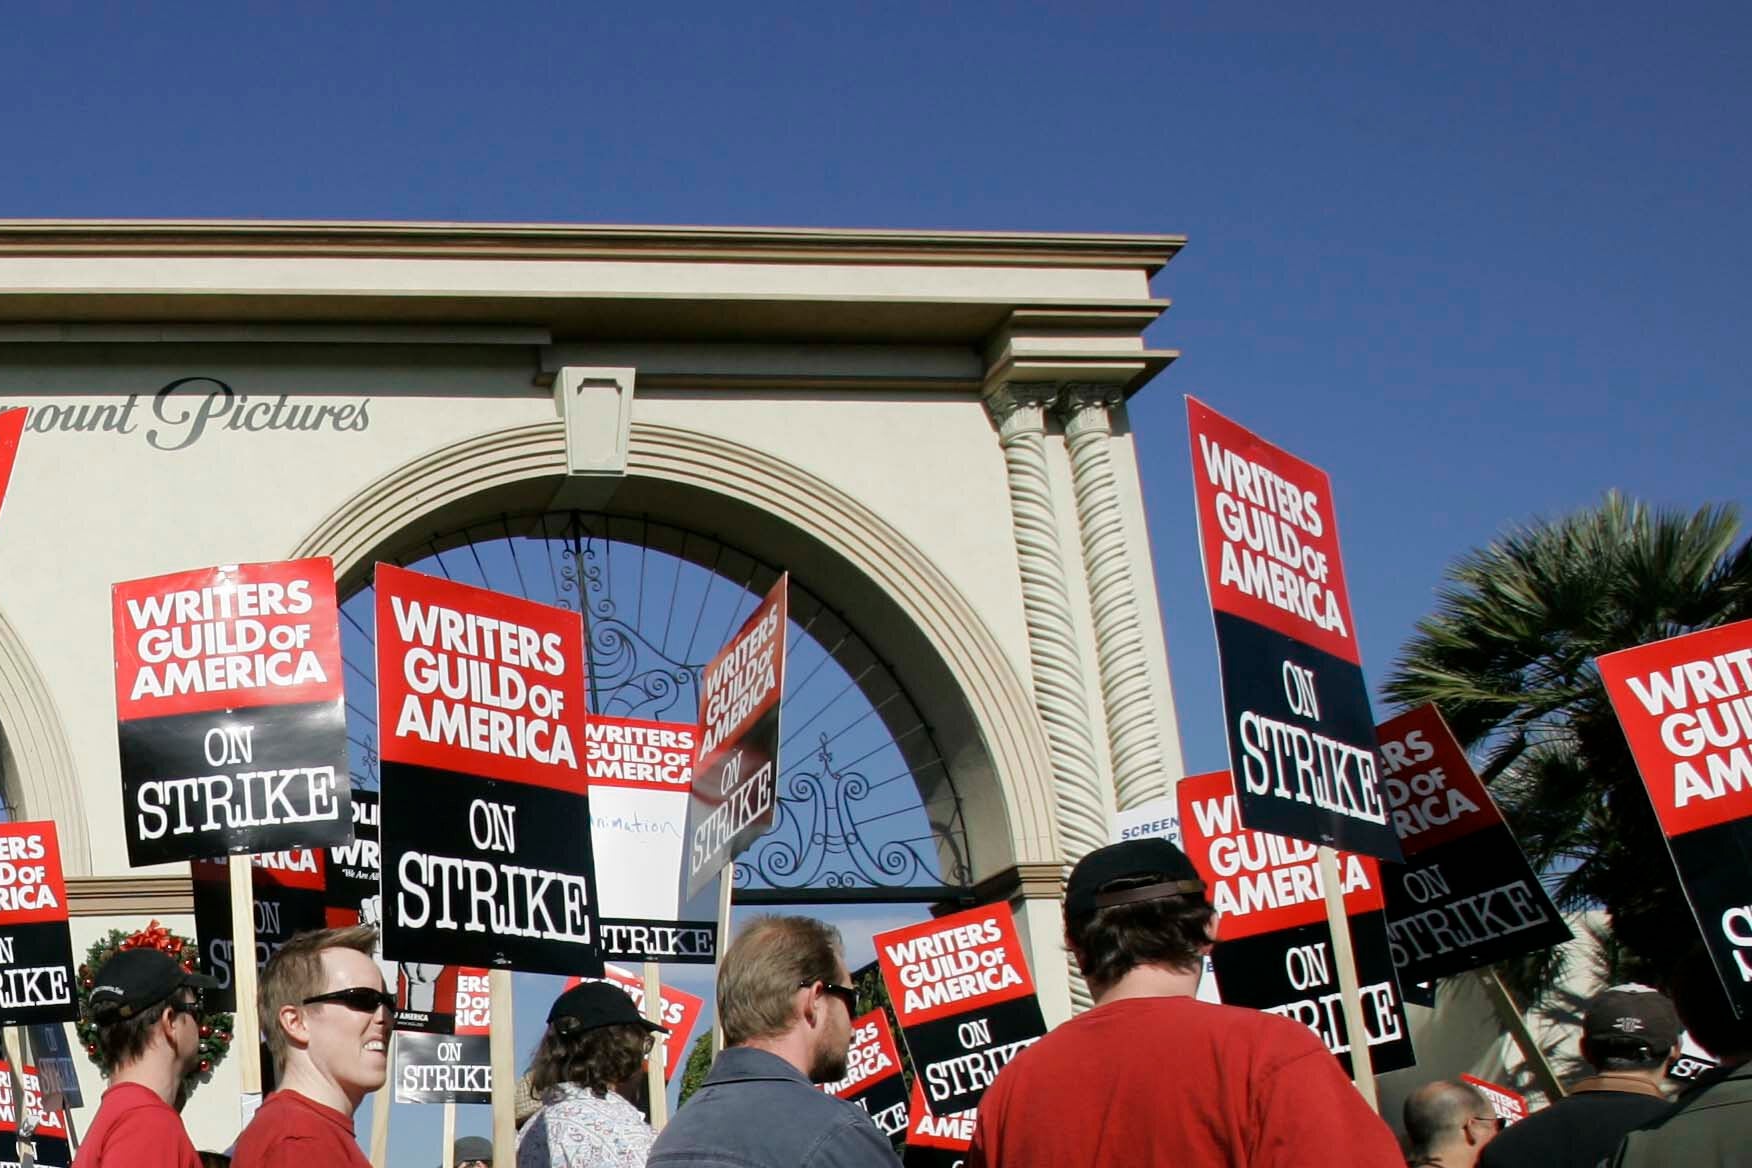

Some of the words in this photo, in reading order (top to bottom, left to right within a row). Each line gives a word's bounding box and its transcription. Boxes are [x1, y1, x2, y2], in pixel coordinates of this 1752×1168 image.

[146, 376, 372, 451] Pictures
[1199, 433, 1322, 537] WRITERS
[1214, 490, 1304, 570] GUILD
[1302, 544, 1328, 583] OF
[127, 579, 313, 630] WRITERS
[1220, 548, 1348, 638] AMERICA
[138, 618, 266, 664] GUILD
[268, 624, 311, 650] OF
[390, 595, 565, 678] WRITERS
[706, 603, 778, 701] WRITERS
[130, 651, 328, 701] AMERICA
[404, 647, 528, 712] GUILD
[528, 684, 564, 721] OF
[705, 664, 758, 728] GUILD
[754, 645, 775, 676] OF
[1282, 660, 1320, 722] ON
[395, 695, 578, 771] AMERICA
[699, 671, 776, 763] AMERICA
[1660, 696, 1752, 757] GUI
[204, 726, 255, 767] ON
[663, 752, 690, 766] OF
[1240, 711, 1386, 826] STRIKE
[720, 750, 743, 796] ON
[1410, 767, 1448, 797] OF
[137, 766, 339, 841] STRIKE
[469, 799, 517, 854] ON
[589, 809, 682, 839] nimation
[692, 761, 773, 878] STRIKE
[1121, 817, 1180, 840] SCREEN
[18, 866, 45, 884] OF
[397, 850, 591, 945] STRIKE
[1404, 863, 1451, 904] ON
[885, 918, 1002, 968] WRITERS
[899, 950, 981, 989] GUILD
[979, 947, 1006, 970] OF
[1285, 942, 1330, 991] ON
[903, 963, 1023, 1014] AMERICA
[437, 1042, 463, 1062] ON
[862, 1041, 881, 1061] OF
[958, 1018, 992, 1050] ON
